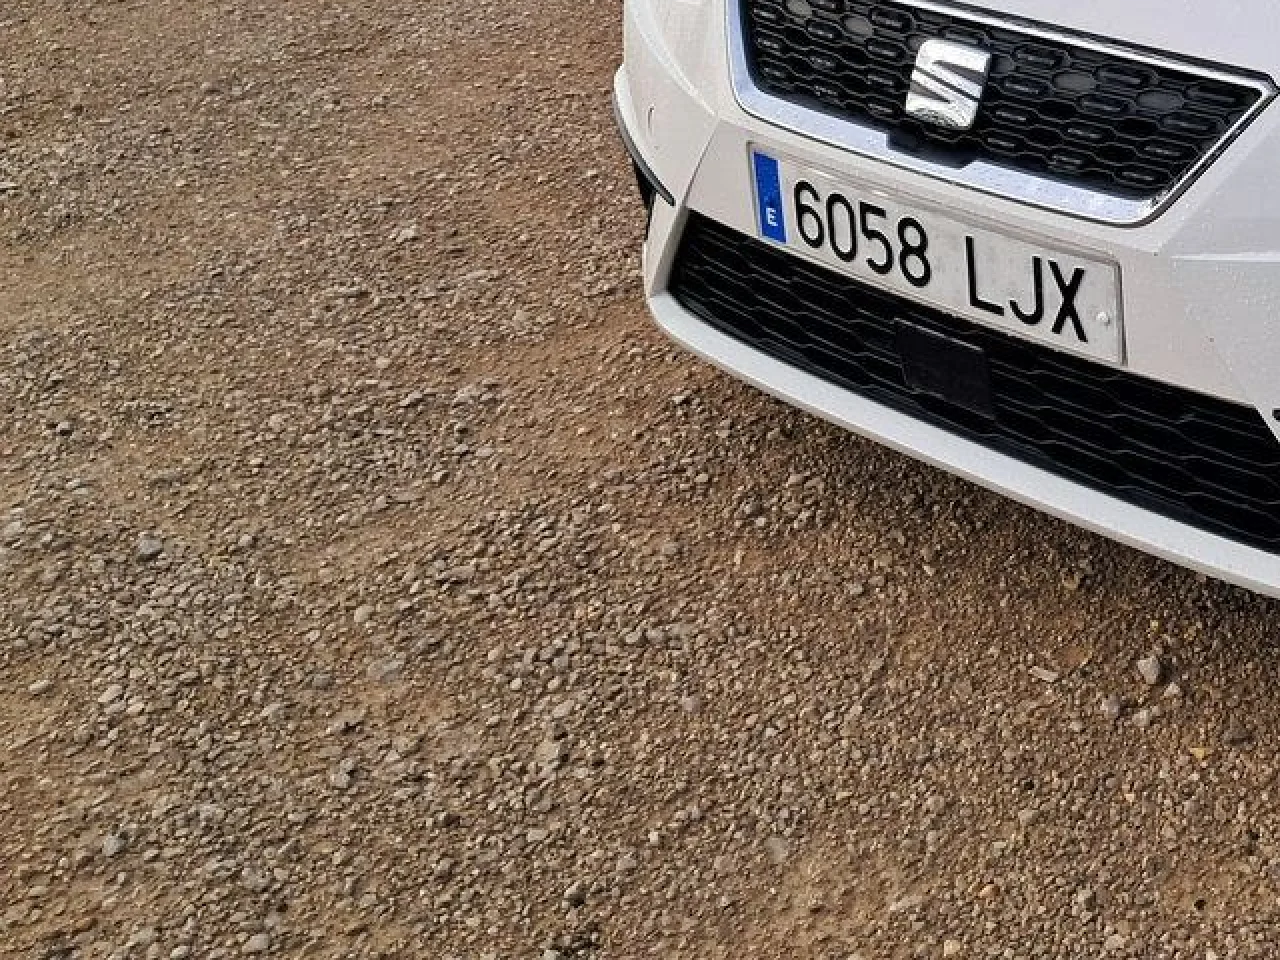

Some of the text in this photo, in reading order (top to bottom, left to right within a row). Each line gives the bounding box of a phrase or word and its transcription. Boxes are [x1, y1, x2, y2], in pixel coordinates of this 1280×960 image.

[766, 207, 778, 227] E
[793, 179, 1087, 343] 6058 LJX
